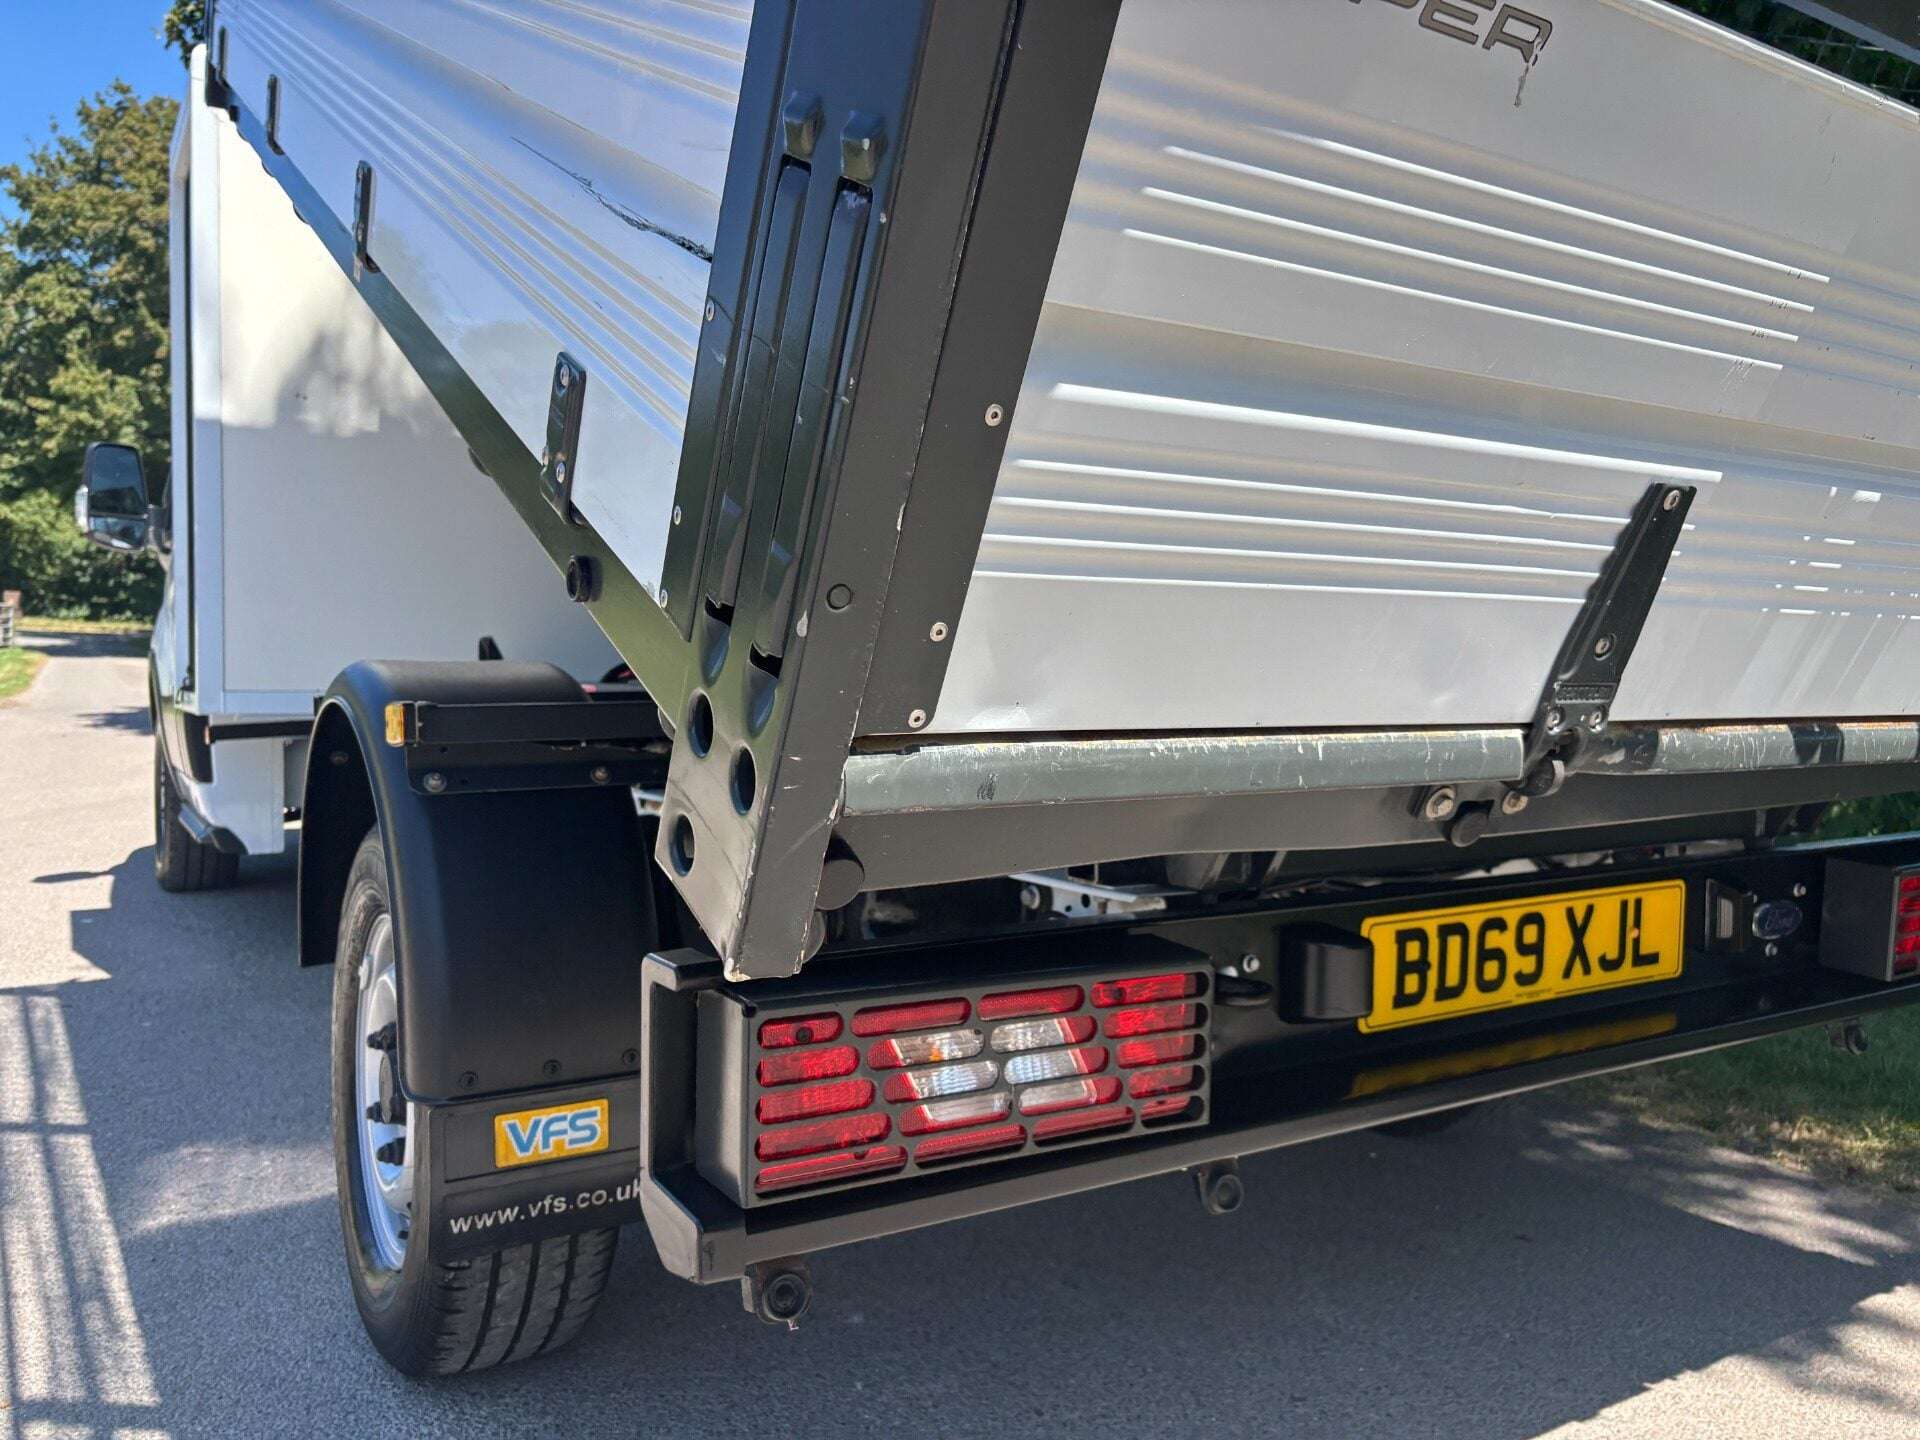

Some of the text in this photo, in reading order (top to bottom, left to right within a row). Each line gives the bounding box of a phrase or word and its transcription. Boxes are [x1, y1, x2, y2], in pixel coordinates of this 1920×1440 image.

[1349, 0, 1553, 65] ER
[1392, 896, 1660, 1010] BD69 XJL
[505, 1108, 599, 1155] VFS
